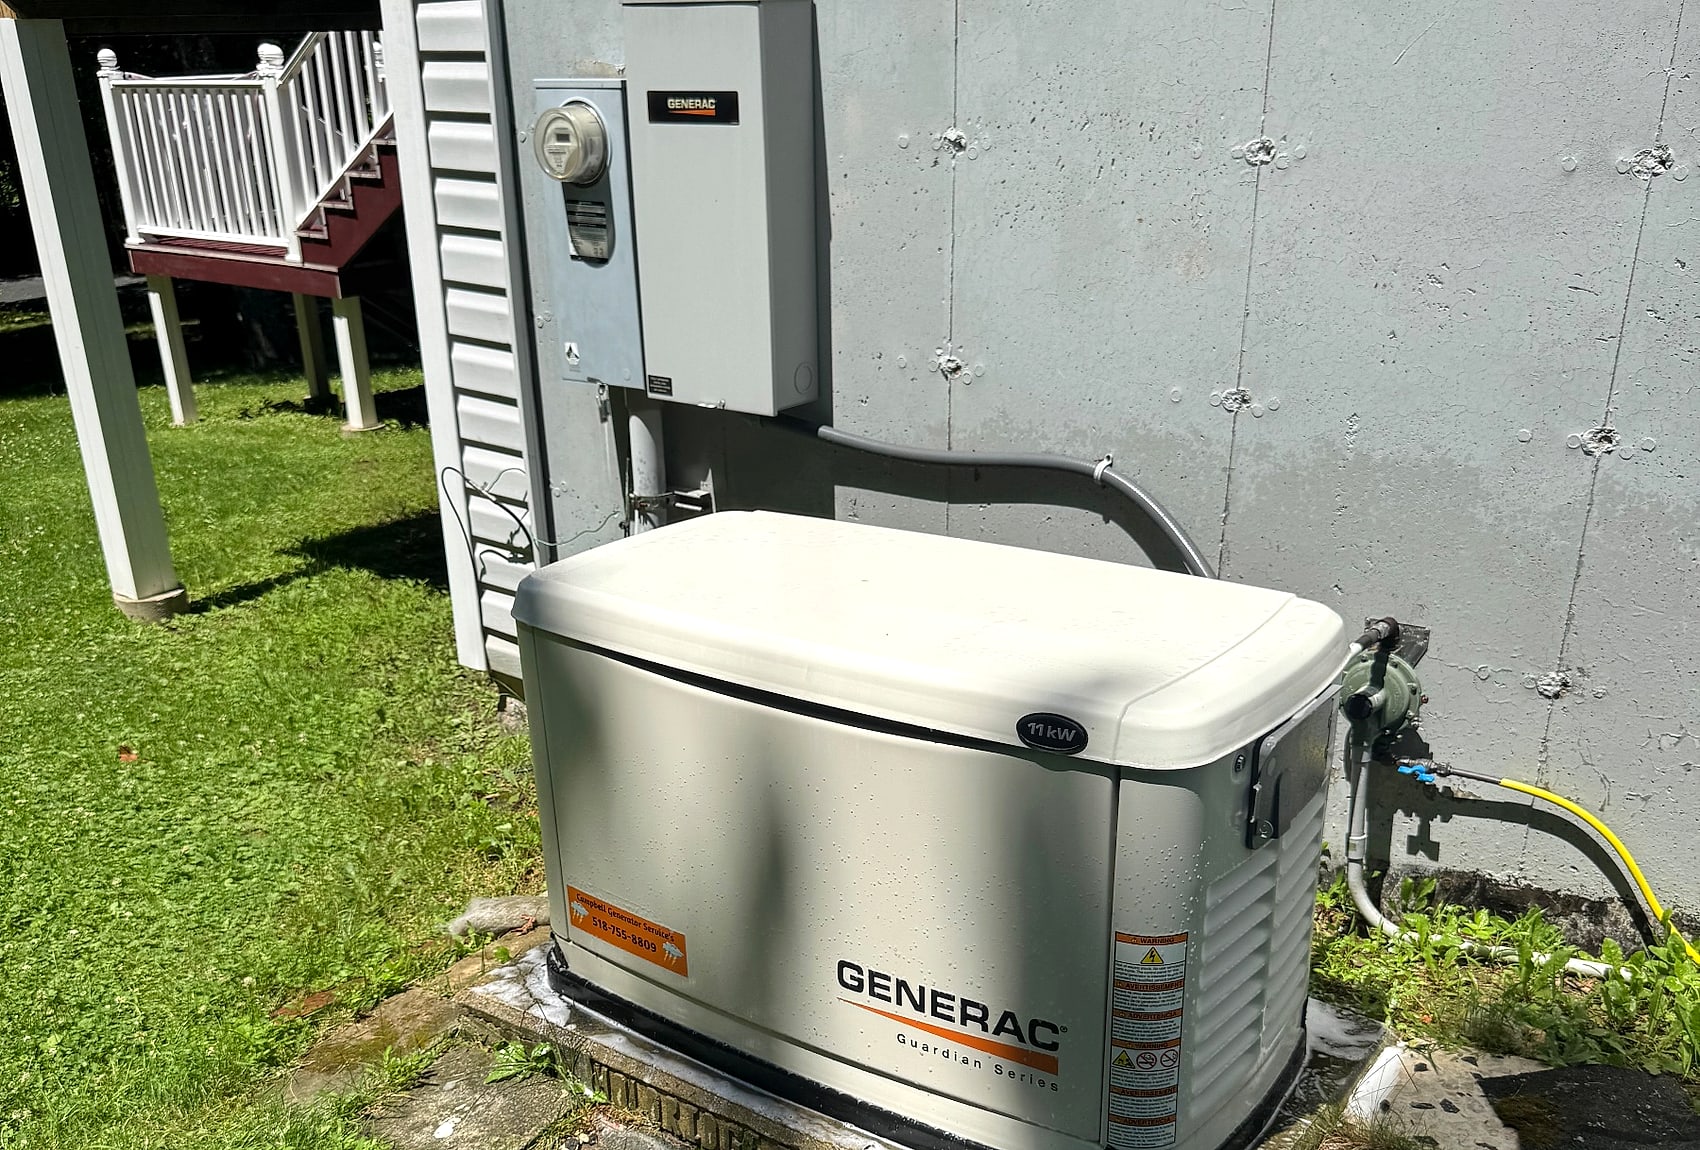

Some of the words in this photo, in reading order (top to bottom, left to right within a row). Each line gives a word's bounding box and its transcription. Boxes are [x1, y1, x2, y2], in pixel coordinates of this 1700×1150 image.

[667, 97, 716, 110] GENERAC
[1027, 723, 1044, 736] 11
[1047, 726, 1077, 742] kW
[576, 893, 607, 913] Campbell
[607, 907, 642, 928] Generator
[643, 922, 675, 942] Service's
[591, 916, 657, 952] 518-755-8809
[836, 959, 1060, 1052] GENERAC
[896, 1032, 983, 1070] Guardian
[993, 1063, 1059, 1092] Series
